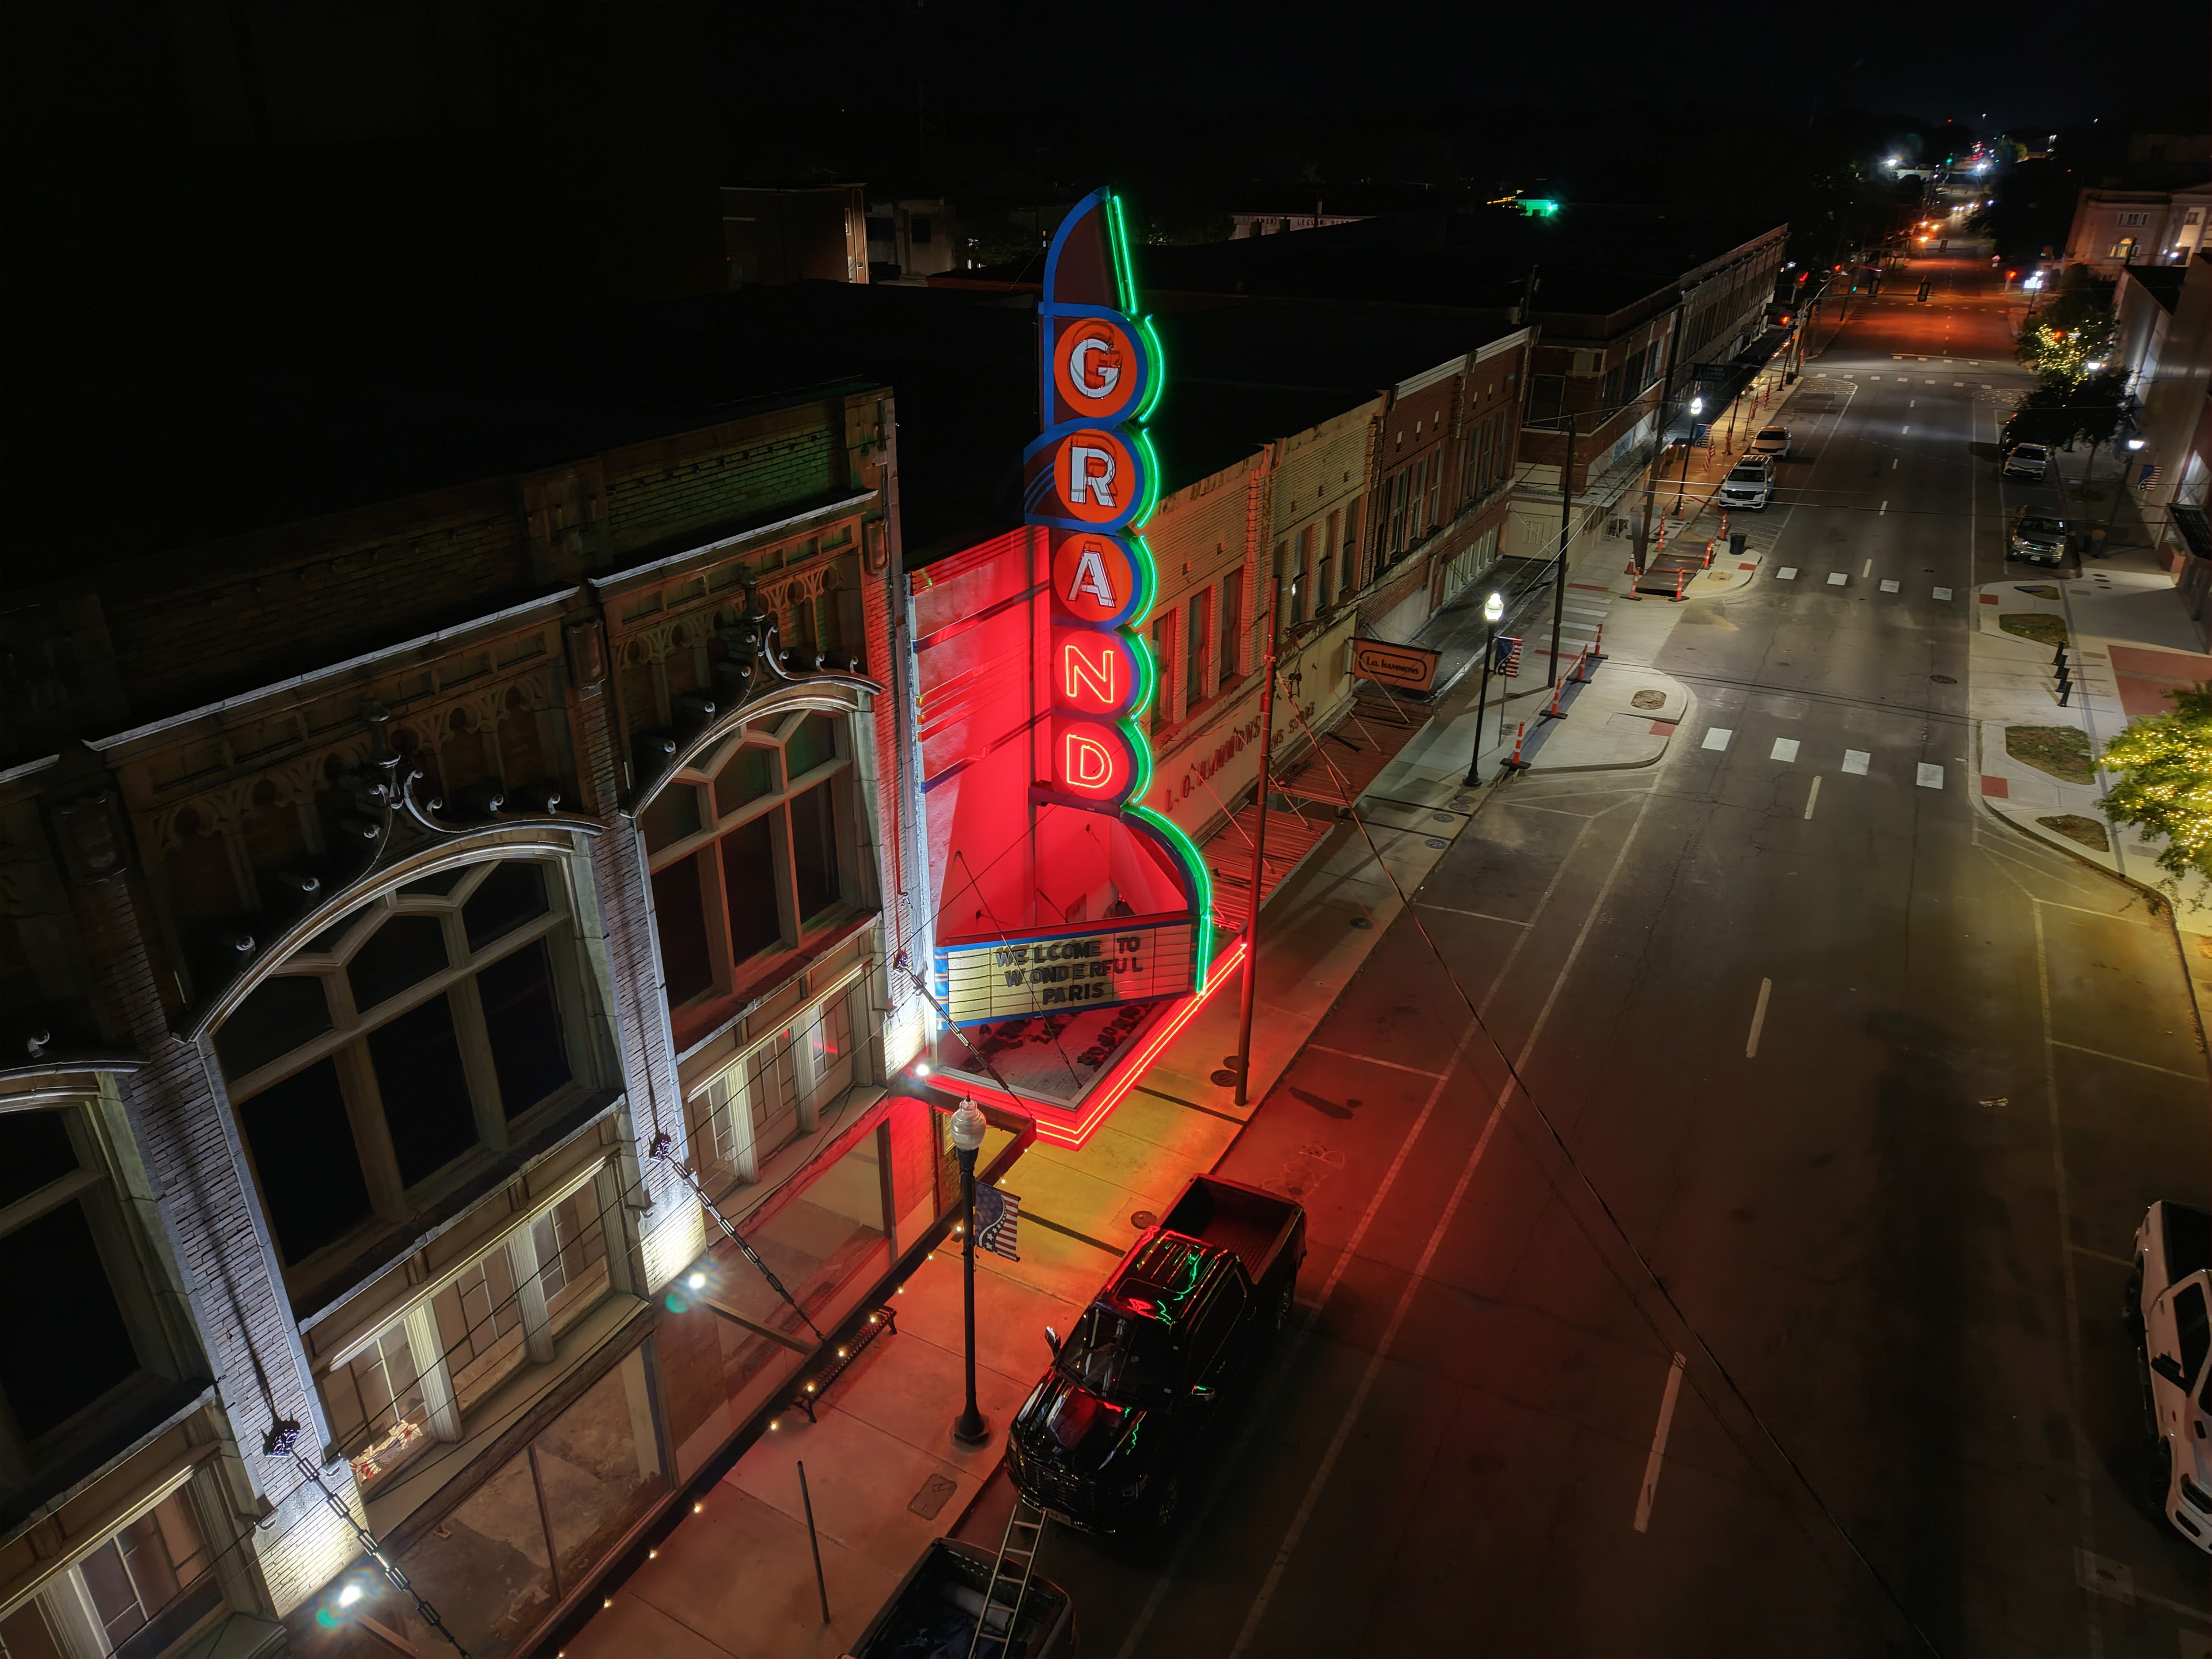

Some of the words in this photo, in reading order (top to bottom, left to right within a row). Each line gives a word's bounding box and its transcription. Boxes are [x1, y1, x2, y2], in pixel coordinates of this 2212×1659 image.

[1065, 338, 1122, 789] GRAND
[995, 940, 1101, 968] WELCOME
[1116, 937, 1141, 954] TO
[1004, 957, 1143, 987] WONDERFUL
[1043, 982, 1104, 1005] PARIS
